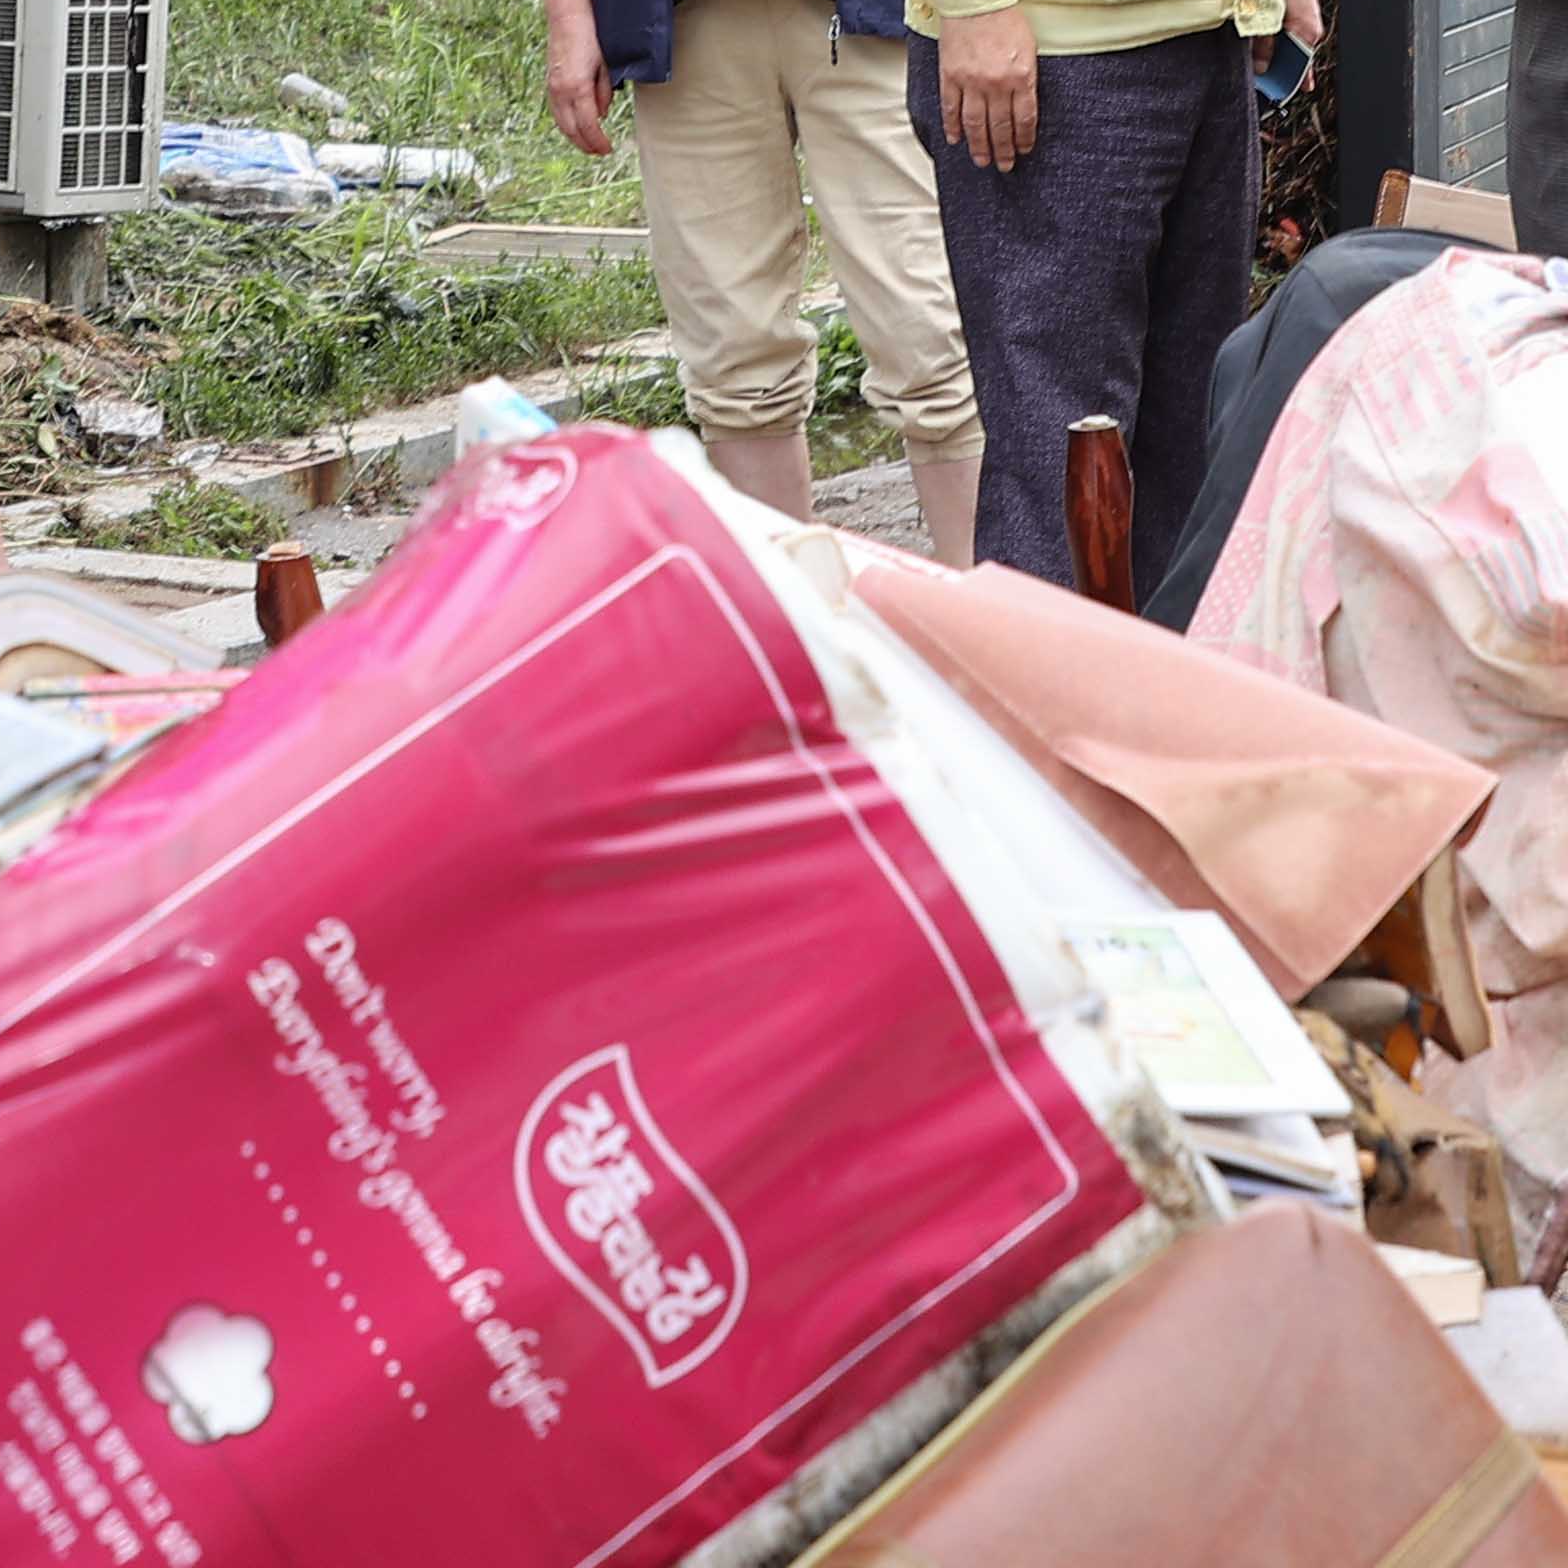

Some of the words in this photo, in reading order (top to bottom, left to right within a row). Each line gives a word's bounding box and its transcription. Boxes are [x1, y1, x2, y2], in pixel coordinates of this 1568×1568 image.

[305, 918, 382, 1022] Don't
[362, 1019, 444, 1137] worry,
[247, 958, 398, 1171] Everything's
[359, 1171, 464, 1280] gonna
[449, 1269, 500, 1318] be
[476, 1319, 563, 1436] alright.
[542, 1095, 727, 1346] 잘풀리는집
